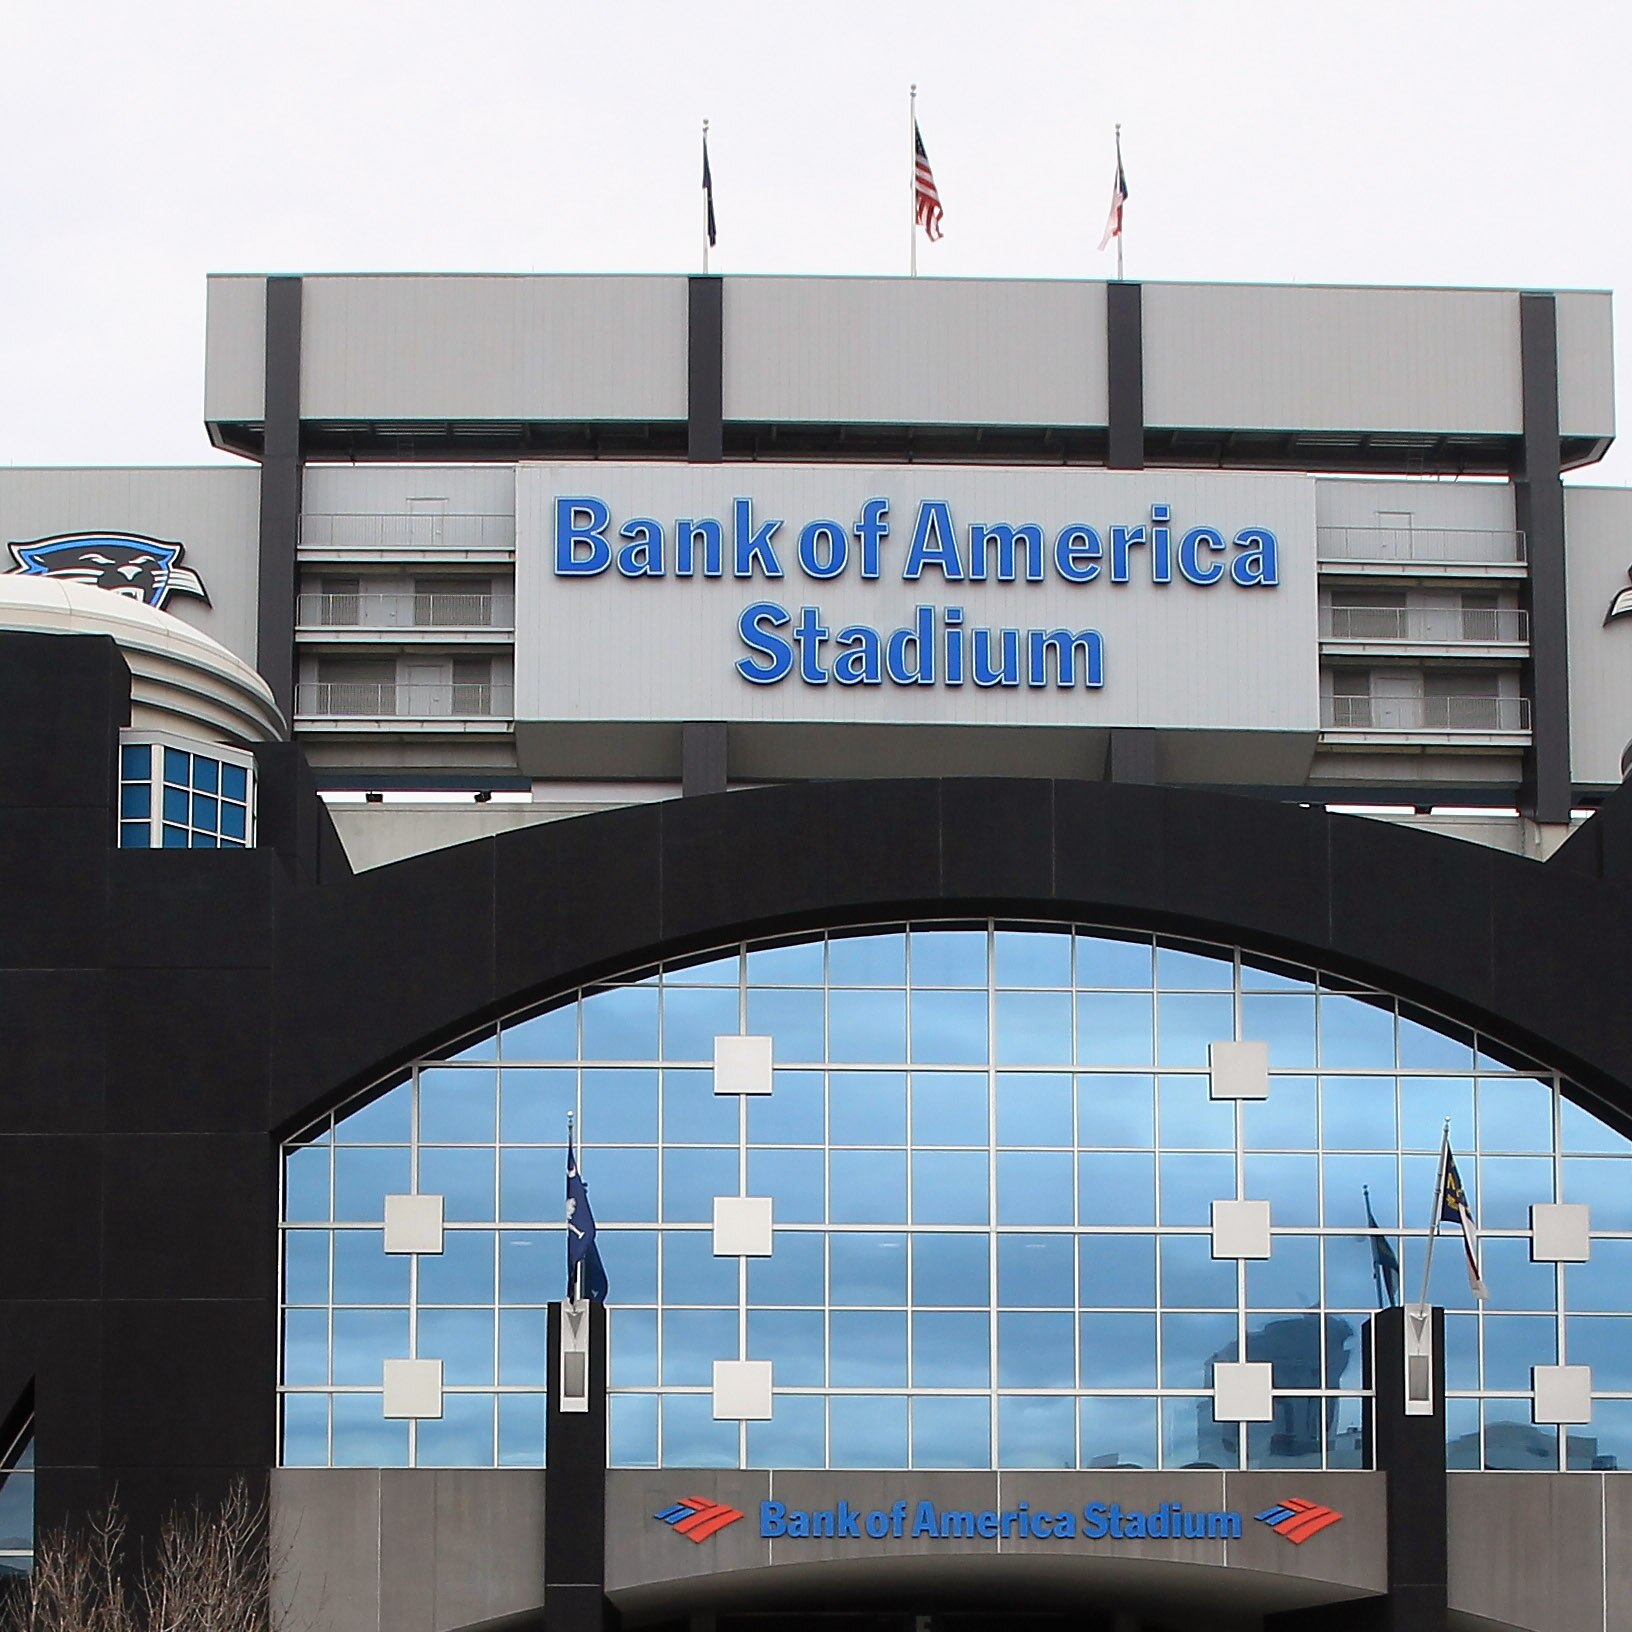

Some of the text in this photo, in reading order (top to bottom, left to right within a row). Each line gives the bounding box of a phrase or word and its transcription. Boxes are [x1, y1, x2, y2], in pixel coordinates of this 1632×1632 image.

[554, 496, 1280, 587] Bank of America
[735, 600, 1105, 688] Stadium
[760, 1501, 1243, 1540] Bank of America Stadium
